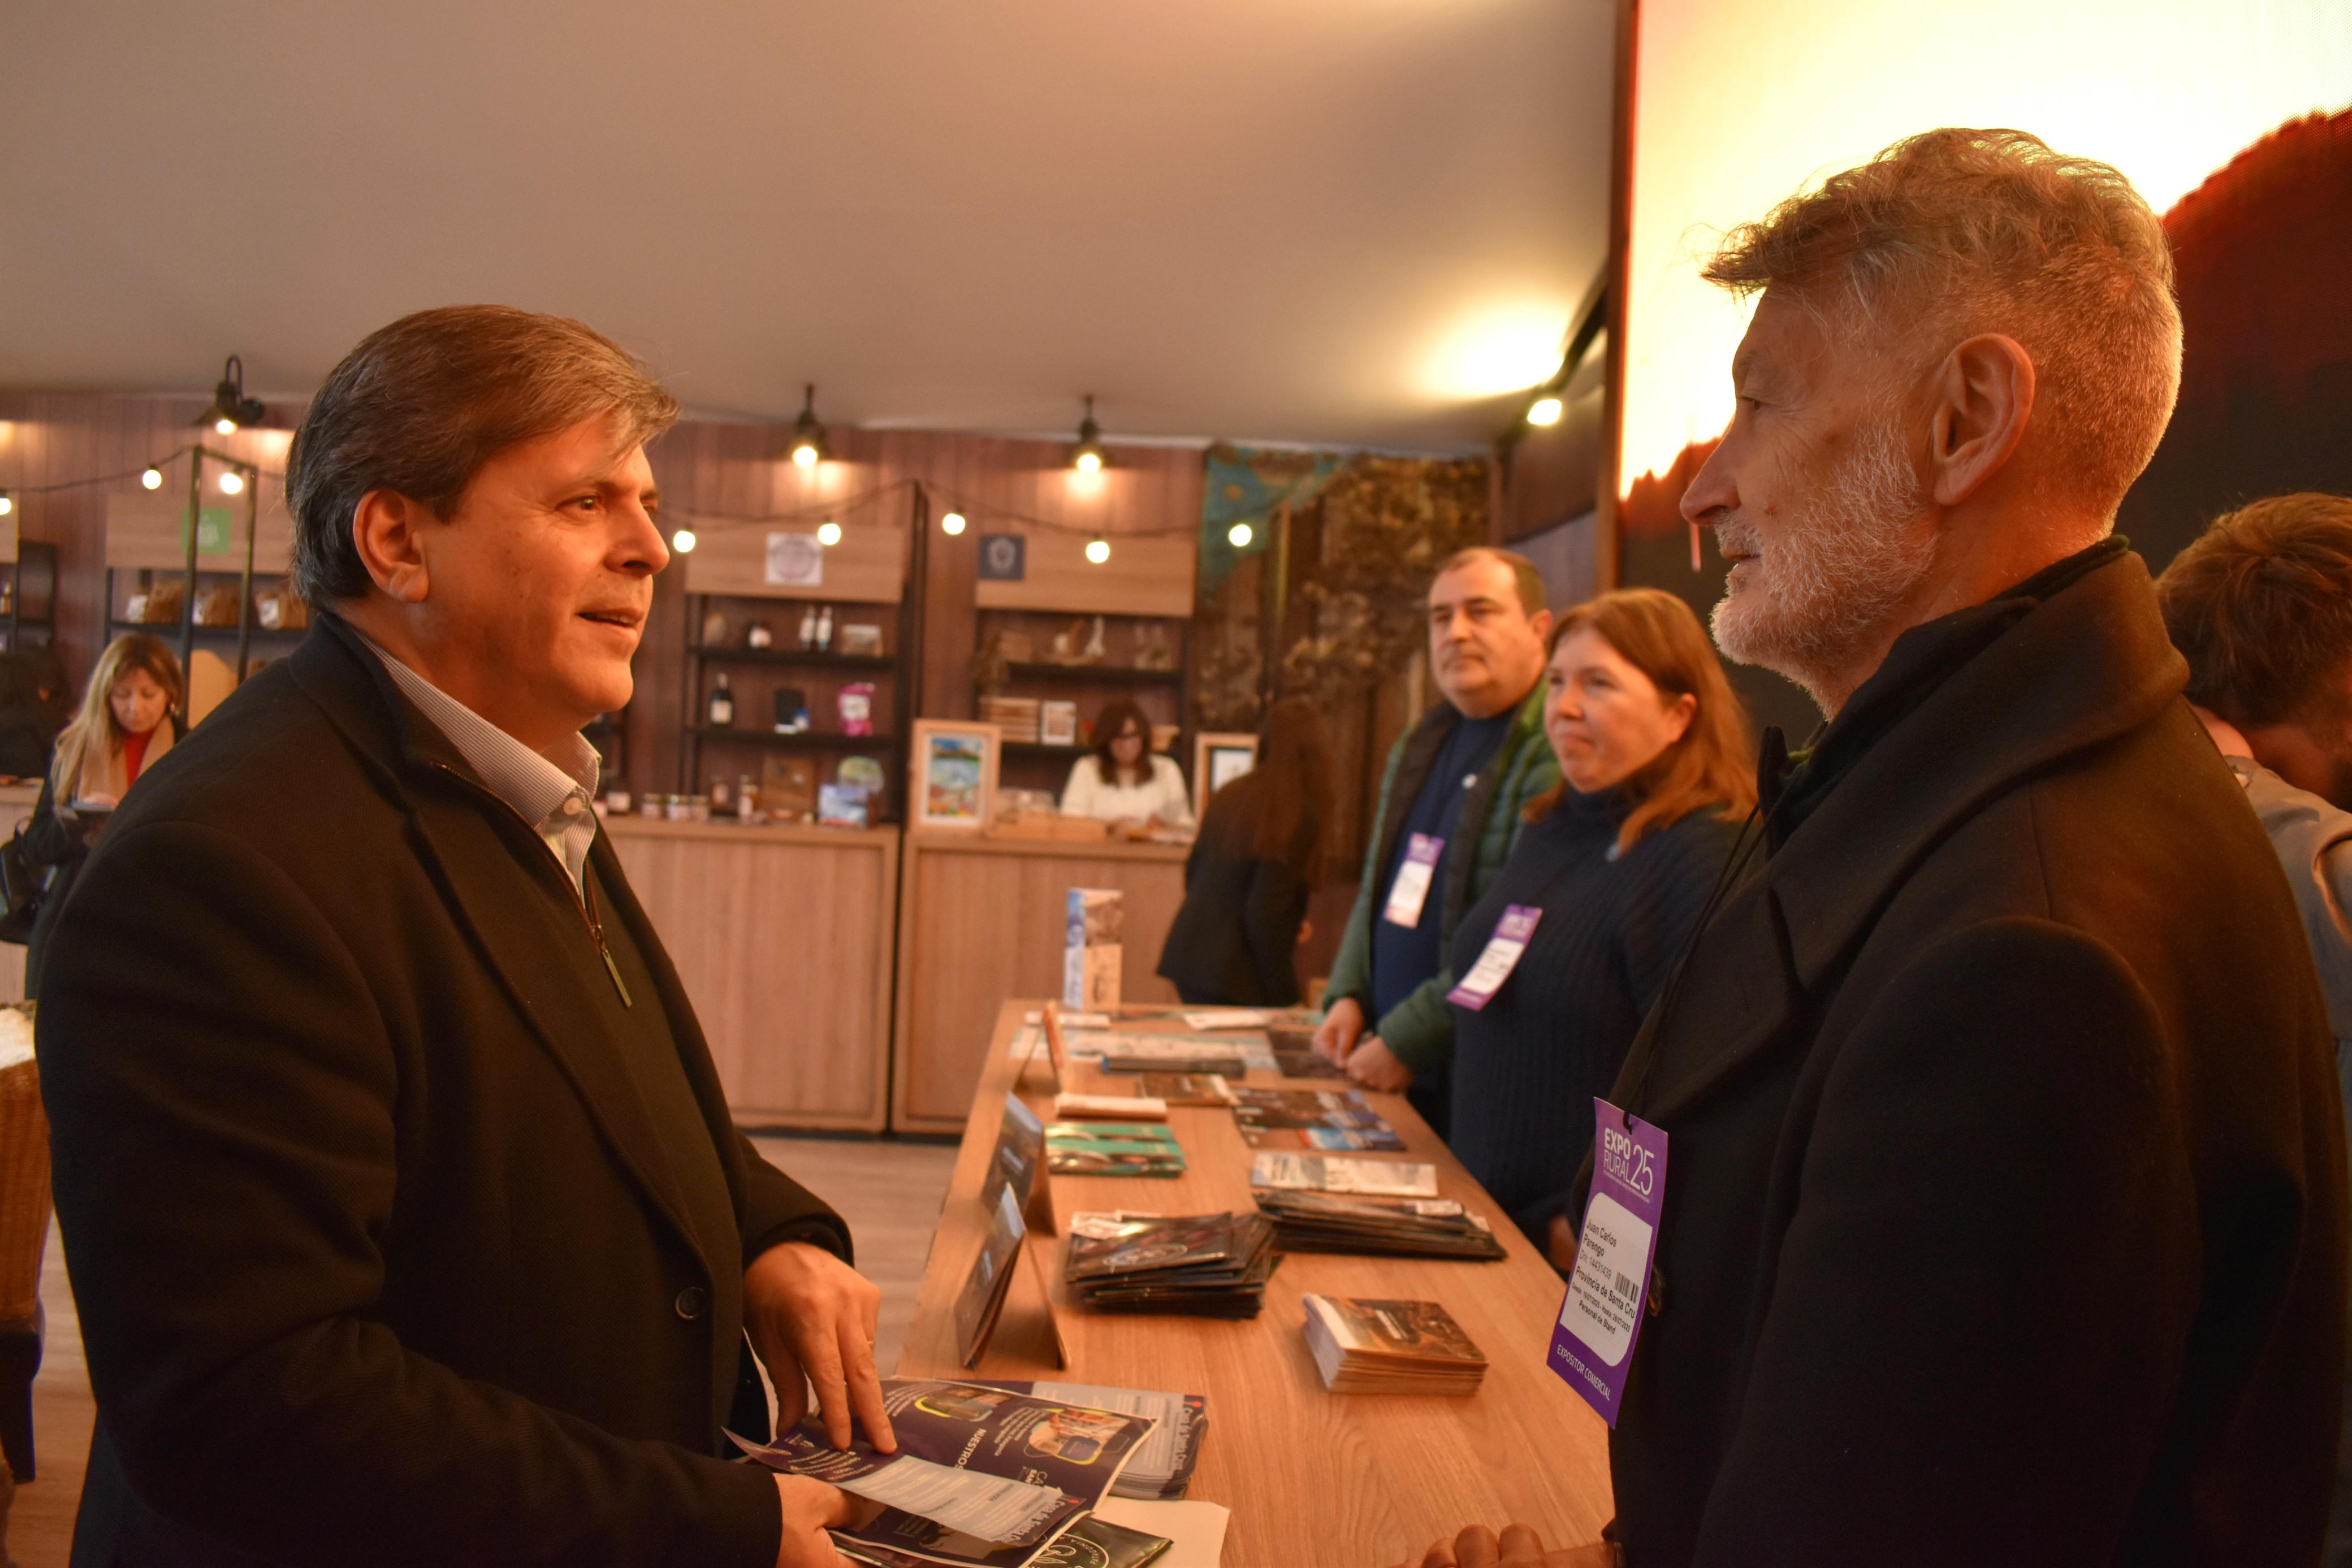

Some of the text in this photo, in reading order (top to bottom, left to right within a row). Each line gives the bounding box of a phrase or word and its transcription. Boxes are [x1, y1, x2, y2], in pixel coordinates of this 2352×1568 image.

[1603, 1150, 1630, 1183] RURAL
[1605, 1128, 1631, 1160] EXPO
[1631, 1145, 1654, 1195] 25
[1583, 1233, 1605, 1257] Parengo
[1586, 1219, 1616, 1247] Juan Carlos
[1575, 1266, 1636, 1319] Provincia de Santa Cru
[1579, 1300, 1616, 1335] Personal de Stand
[1557, 1344, 1610, 1401] EXPOSITOR COMERCIAL
[954, 1428, 988, 1470] NUESTROS
